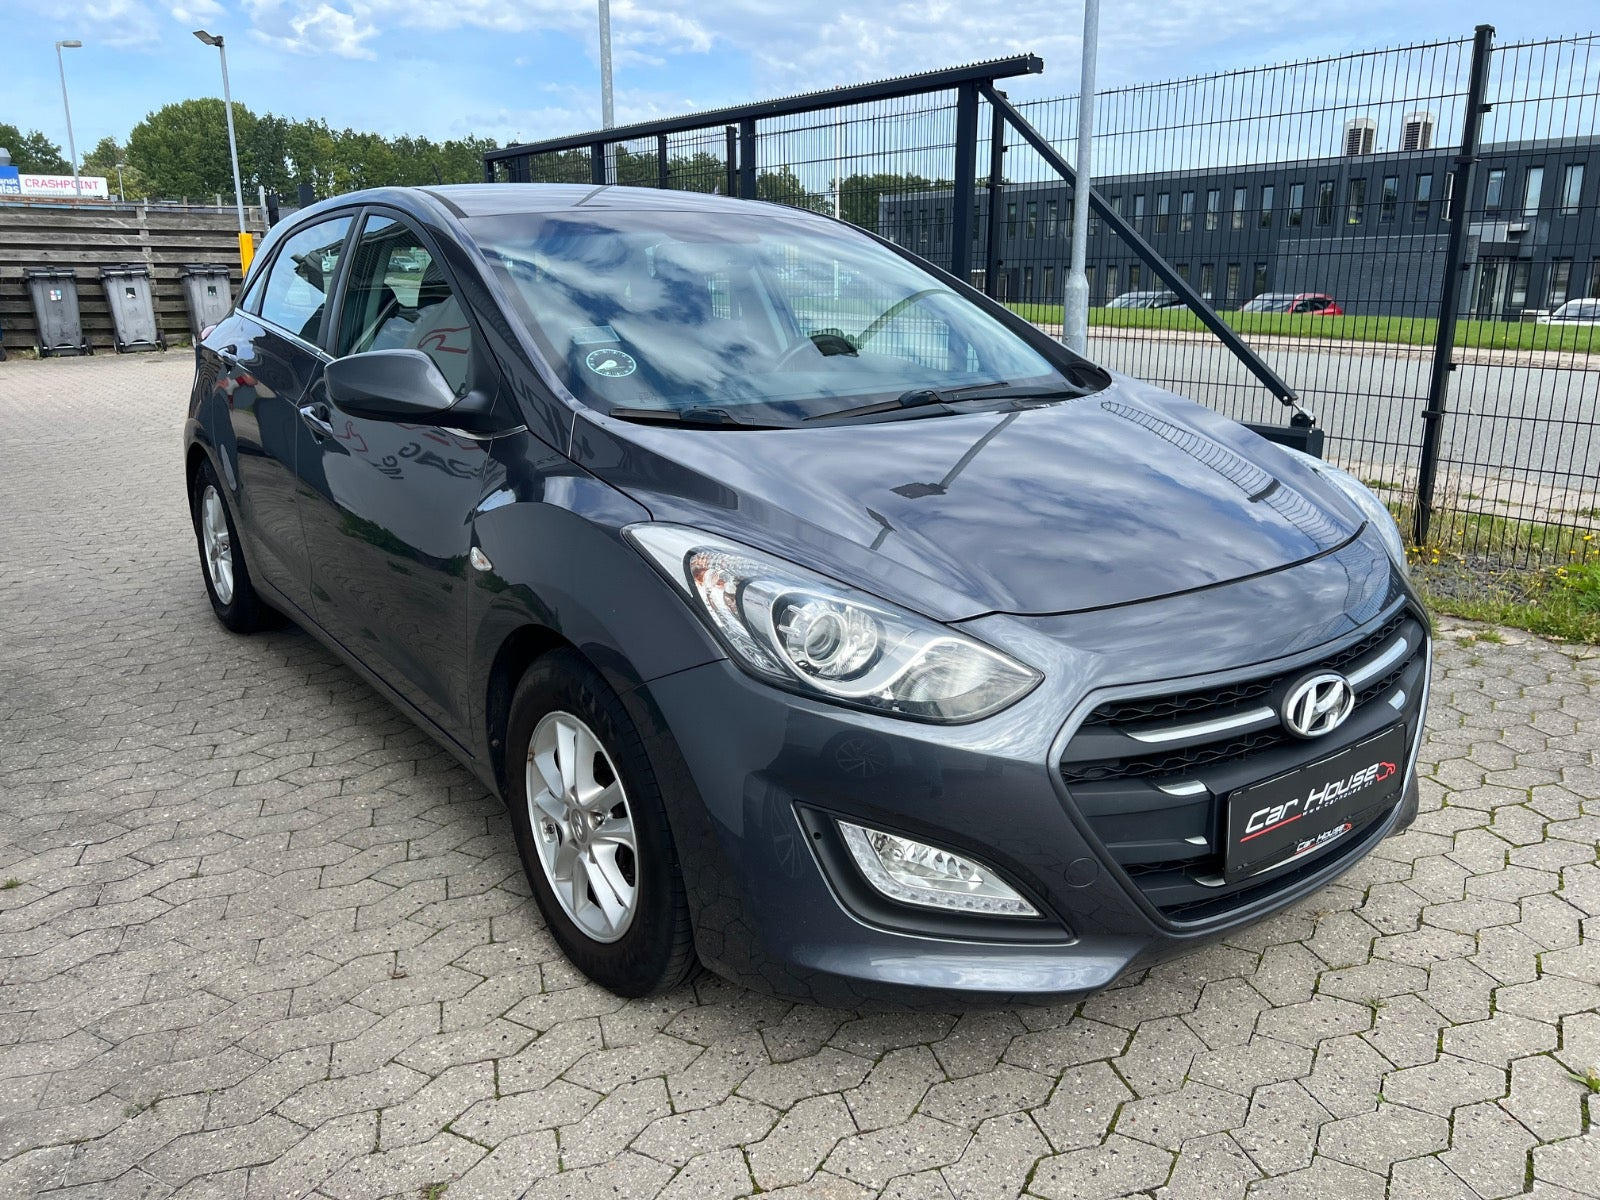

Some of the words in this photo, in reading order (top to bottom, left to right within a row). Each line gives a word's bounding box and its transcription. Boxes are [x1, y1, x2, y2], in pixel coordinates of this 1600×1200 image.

[25, 178, 99, 190] CRASHPOINT
[1245, 798, 1299, 834] Car
[1303, 762, 1380, 811] House
[1296, 837, 1316, 852] Car
